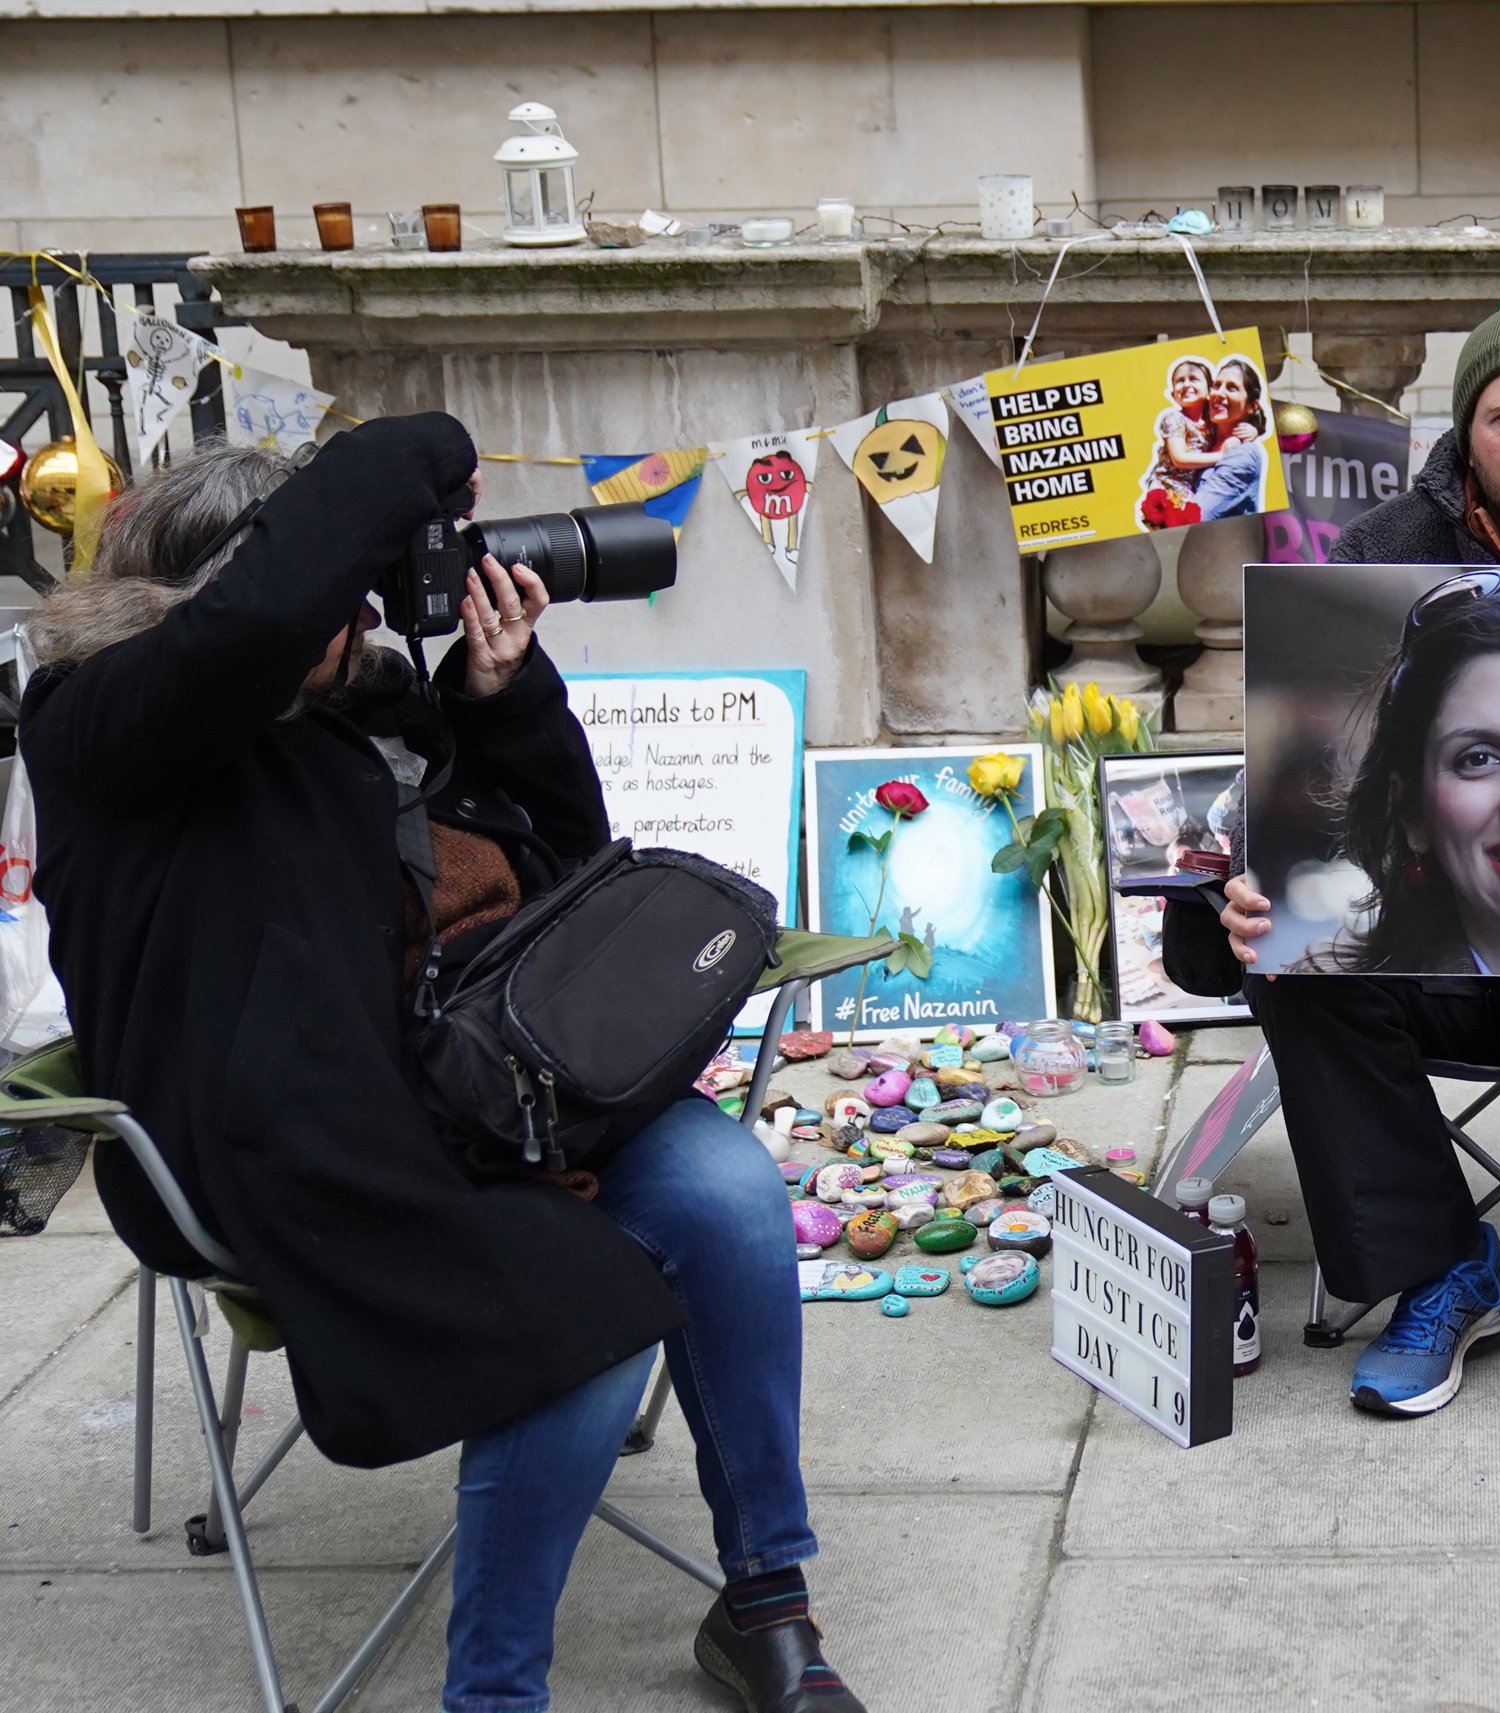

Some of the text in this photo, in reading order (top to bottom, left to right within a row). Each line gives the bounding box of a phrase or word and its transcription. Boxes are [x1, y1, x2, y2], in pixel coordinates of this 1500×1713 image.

[999, 383, 1099, 417] HELP US
[1004, 416, 1079, 445] BRING
[1009, 438, 1119, 474] NAZANIN
[1282, 445, 1398, 500] rime
[1014, 471, 1088, 502] HOME
[1019, 515, 1091, 538] REDRESS
[582, 692, 680, 726] demands
[690, 698, 715, 722] to
[645, 743, 704, 767] Nazanin
[711, 743, 739, 766] and
[749, 744, 772, 766] the
[622, 778, 639, 791] as
[1054, 1189, 1187, 1302] HUNGER FOR
[1070, 1259, 1178, 1360] JUSTICE
[1076, 1323, 1119, 1380] DAY
